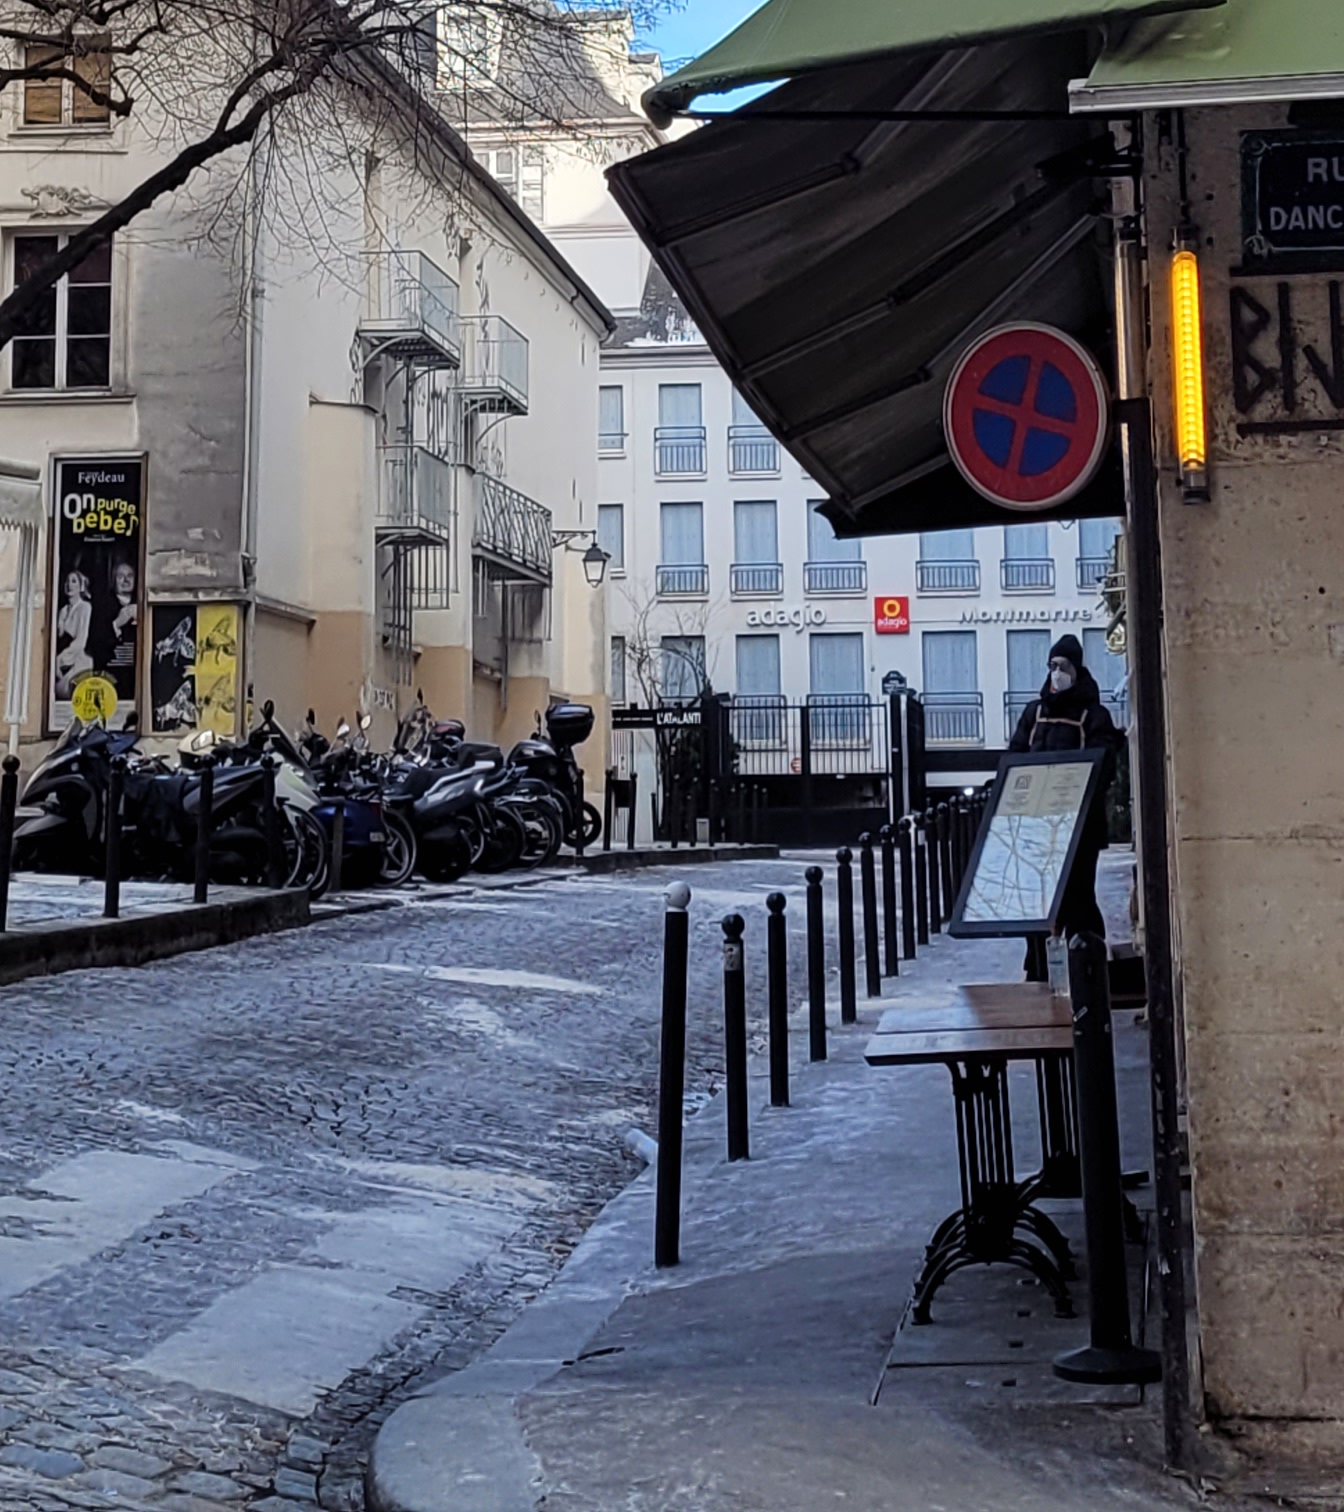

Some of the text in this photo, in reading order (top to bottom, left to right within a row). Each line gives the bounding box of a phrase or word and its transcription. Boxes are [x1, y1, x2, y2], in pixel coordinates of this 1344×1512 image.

[78, 471, 125, 486] Feydeau
[63, 493, 136, 519] On purge
[747, 602, 826, 633] adagio
[877, 615, 908, 628] adagio
[960, 606, 1093, 624] Montmartre
